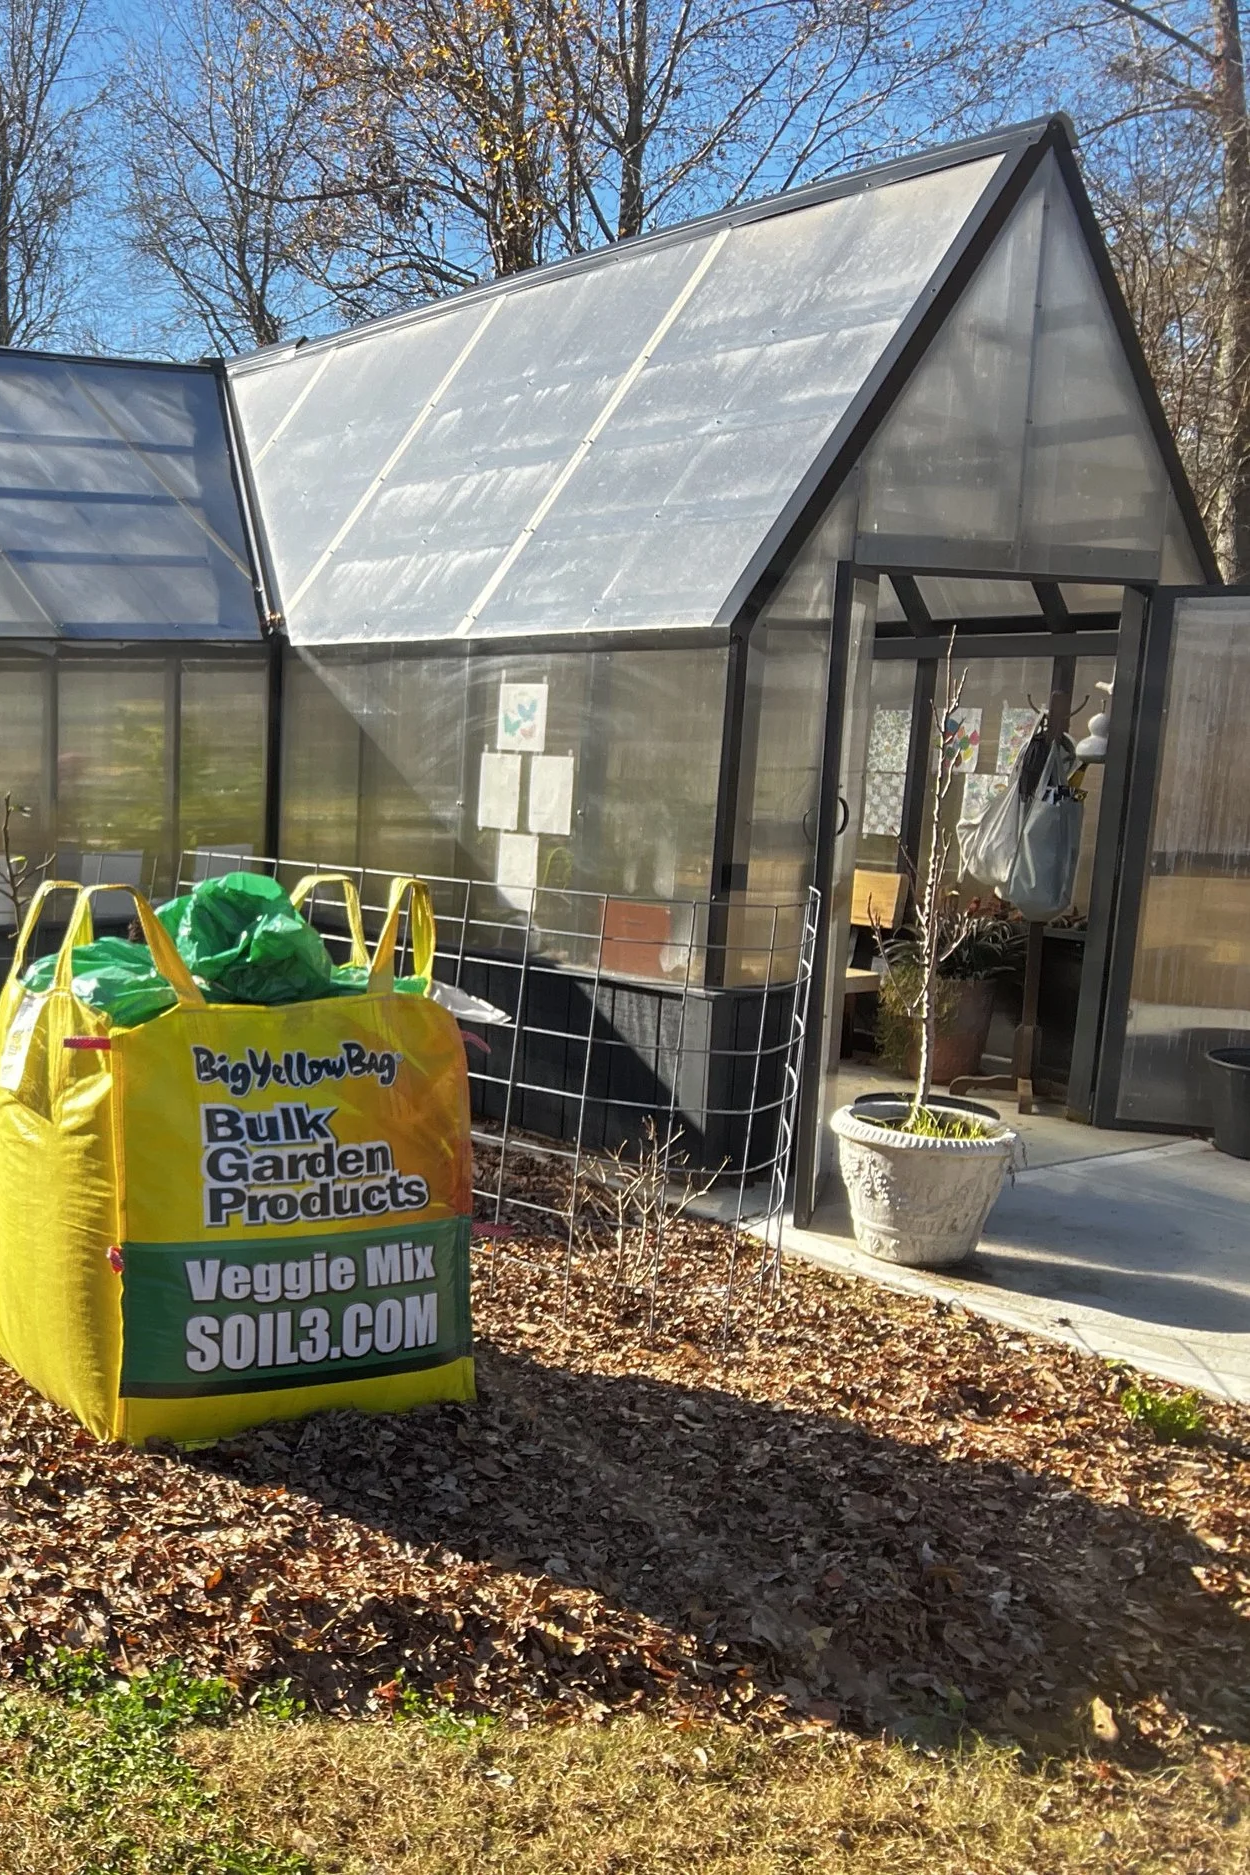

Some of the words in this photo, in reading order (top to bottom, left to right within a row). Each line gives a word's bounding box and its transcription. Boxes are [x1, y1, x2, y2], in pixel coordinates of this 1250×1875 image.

[204, 1104, 337, 1144] Bulk
[206, 1142, 392, 1183] Garden
[207, 1174, 429, 1224] Products
[185, 1252, 356, 1303] Veggie
[365, 1241, 436, 1288] Mix
[185, 1292, 438, 1373] SOIL3.COM
